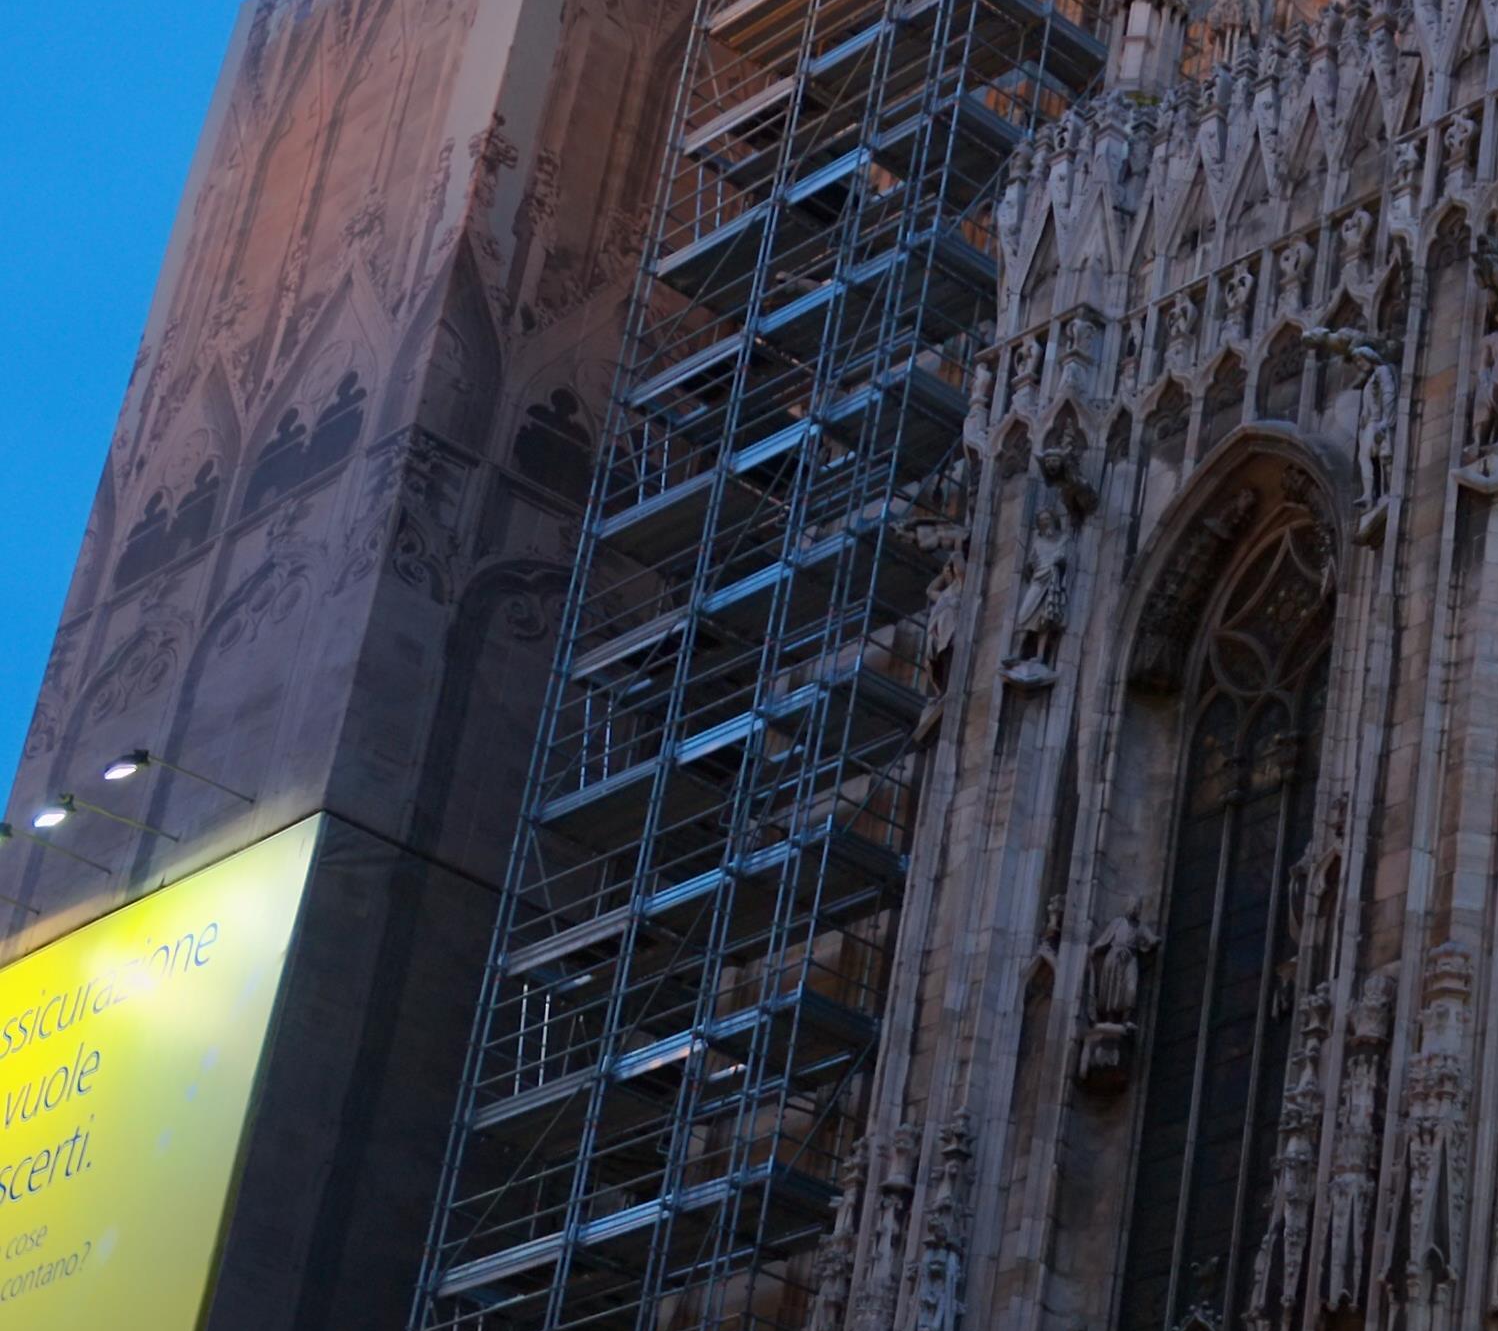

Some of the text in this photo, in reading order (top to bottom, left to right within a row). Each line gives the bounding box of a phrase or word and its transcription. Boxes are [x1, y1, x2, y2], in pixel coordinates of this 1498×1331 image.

[5, 1041, 100, 1129] vuole
[0, 1240, 92, 1302] contano?
[5, 1225, 48, 1259] cose
